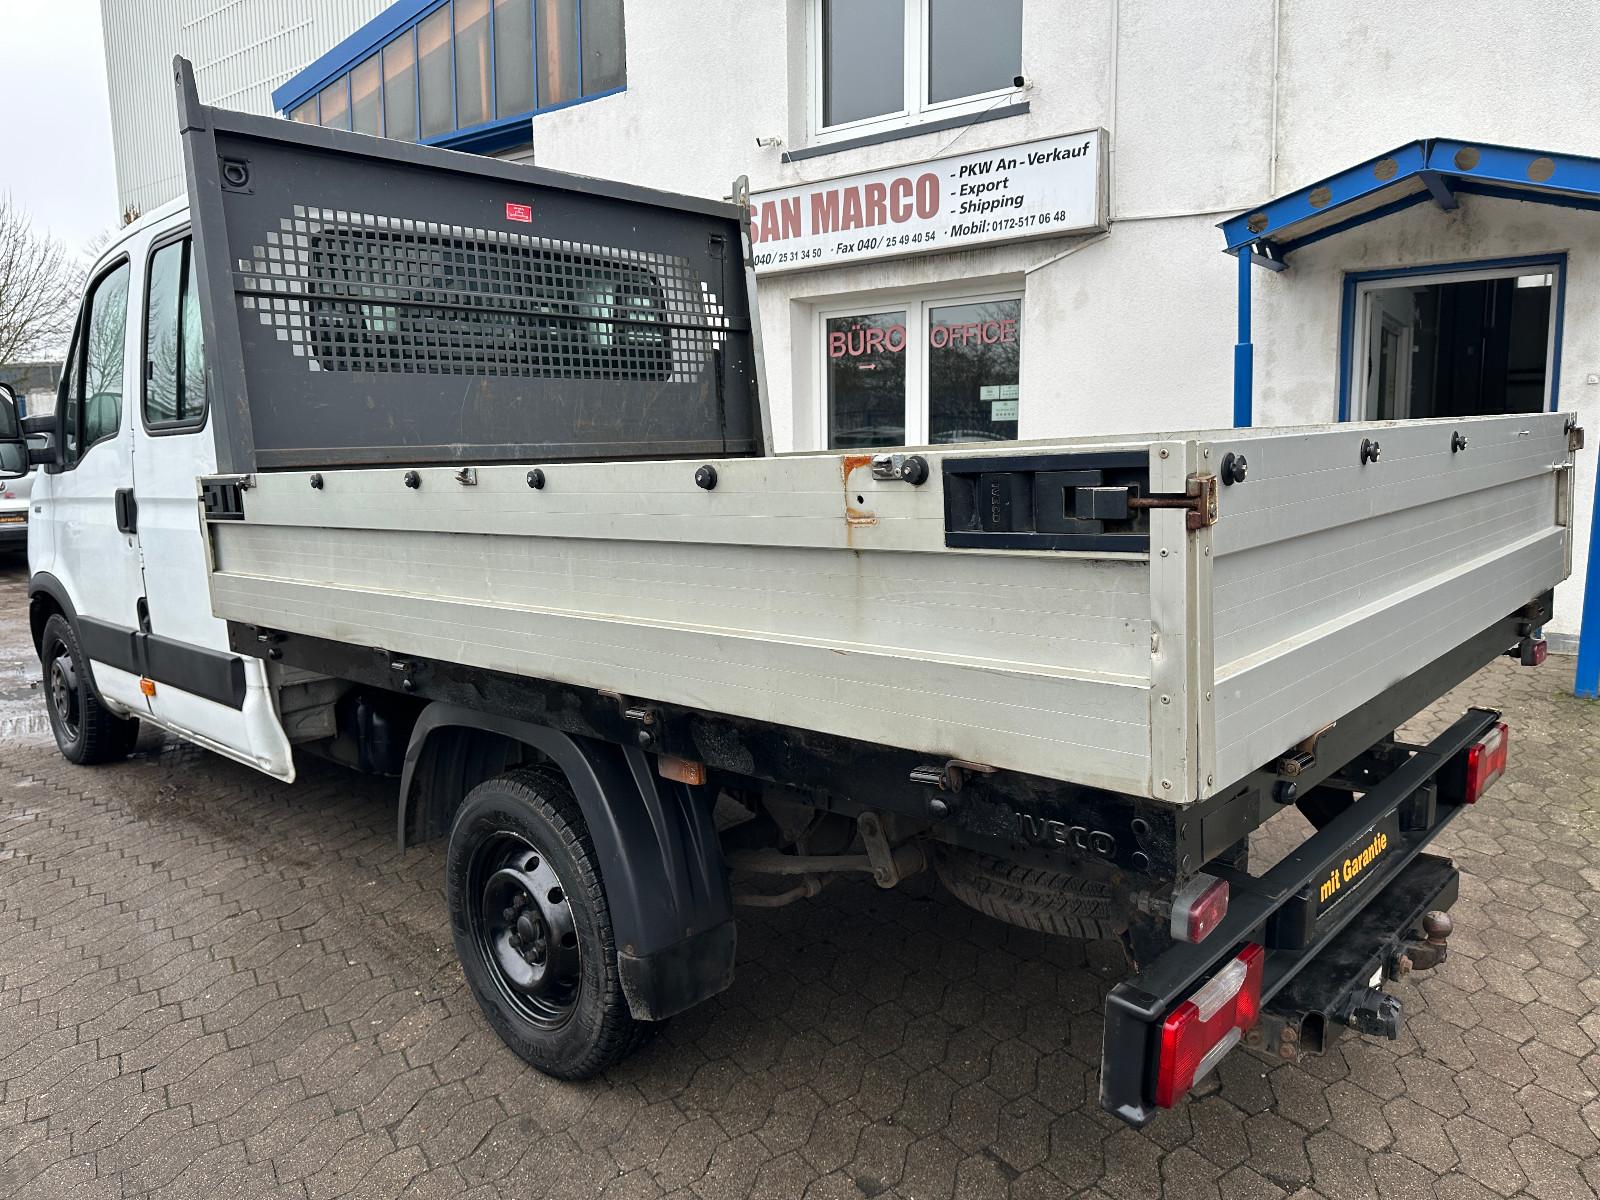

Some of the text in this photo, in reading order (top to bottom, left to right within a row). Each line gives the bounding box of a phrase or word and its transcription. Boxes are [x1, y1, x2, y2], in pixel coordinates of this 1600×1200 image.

[959, 160, 993, 178] PKW
[959, 176, 1009, 197] Export
[811, 172, 940, 236] MARCO
[959, 194, 1024, 215] Shipping
[778, 253, 788, 263] 25
[790, 251, 799, 261] 31
[801, 249, 811, 260] 34
[812, 248, 822, 258] 50
[836, 242, 854, 255] Fax
[886, 236, 897, 247] 25
[899, 234, 910, 245] 49
[912, 233, 923, 244] 40
[925, 231, 936, 242] 54
[950, 220, 990, 238] Mobil:
[992, 215, 1036, 232] 0172-517
[1038, 213, 1051, 224] 06
[1053, 210, 1066, 222] 48
[829, 324, 906, 358] BÜRO
[930, 319, 1016, 349] OFFICE
[1015, 812, 1117, 858] IVECO
[1320, 832, 1387, 903] mit Garantie
